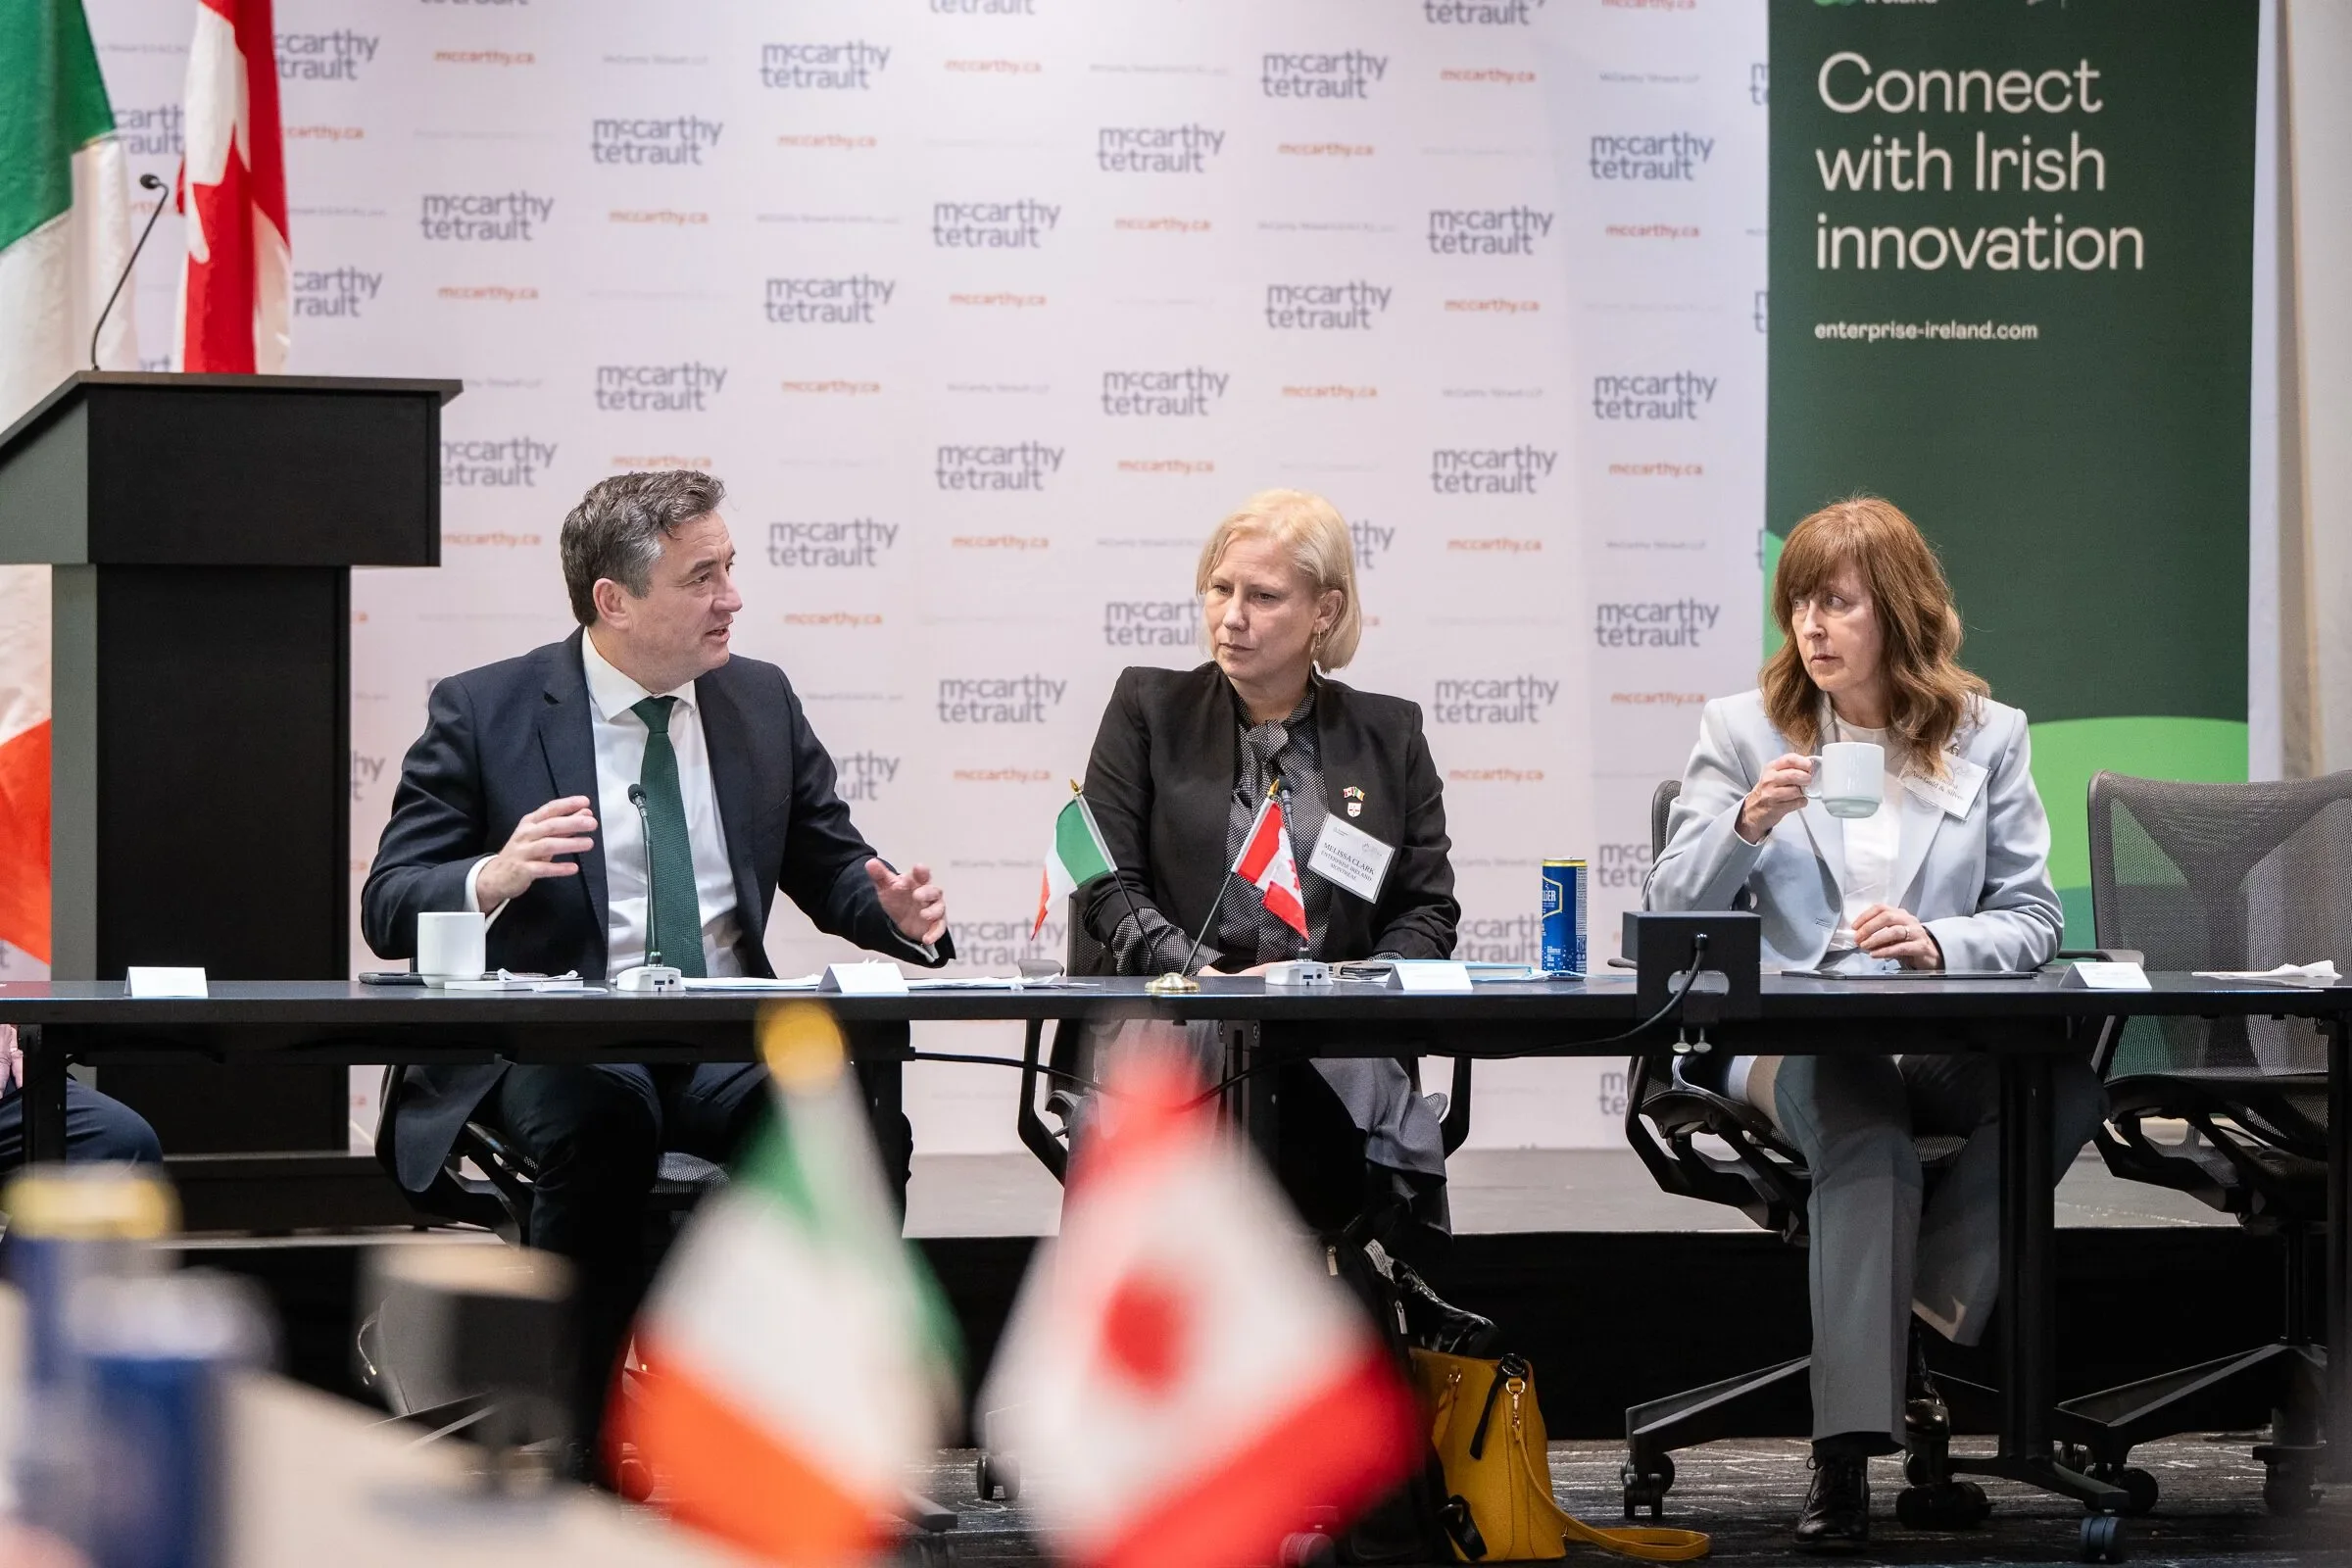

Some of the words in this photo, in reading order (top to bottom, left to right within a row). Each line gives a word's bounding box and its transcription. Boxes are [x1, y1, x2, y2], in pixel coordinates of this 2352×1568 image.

[1422, 0, 1531, 26] tetrault
[274, 28, 381, 63] ccarthy
[763, 39, 891, 73] mccarthy
[278, 54, 359, 80] trault
[760, 64, 869, 90] tetrault
[1264, 49, 1388, 81] mccarthy
[1260, 74, 1367, 99] tetrault
[1818, 52, 2103, 114] Connect
[595, 115, 723, 148] mccarthy
[1101, 123, 1225, 156] mccarthy
[591, 139, 702, 166] tetrault
[1097, 148, 1204, 173] tetrault
[1592, 131, 1715, 164] mccarthy
[1816, 131, 1952, 192] with
[1976, 131, 2105, 192] Irish
[1589, 156, 1694, 181] tetrault
[423, 190, 554, 223] mccarthy
[935, 198, 1060, 230] mccarthy
[419, 215, 532, 241] tetrault
[931, 222, 1040, 248] tetrault
[1431, 206, 1553, 237] mccarthy
[1427, 230, 1533, 255] tetrault
[1817, 214, 2144, 270] innovation
[767, 273, 896, 306] mccarthy
[1268, 280, 1392, 313] mccarthy
[294, 293, 361, 318] rault
[763, 298, 874, 323] tetrault
[1264, 305, 1371, 330] tetrault
[1814, 320, 2039, 343] enterprise-ireland.com
[598, 362, 727, 394] mccarthy
[1104, 367, 1230, 399] mccarthy
[1595, 370, 1718, 403] mccarthy
[594, 386, 706, 412] tetrault
[1101, 391, 1209, 416] tetrault
[1592, 395, 1697, 420] tetrault
[939, 440, 1065, 473] mccarthy
[1435, 444, 1557, 476] mccarthy
[440, 463, 536, 488] etrault
[935, 465, 1045, 491] tetrault
[1431, 468, 1537, 494] tetrault
[770, 517, 899, 550] mccarthy
[766, 542, 877, 567] tetrault
[1597, 598, 1720, 630] mccarthy
[1593, 622, 1699, 648] tetrault
[941, 673, 1067, 706] mccarthy
[1437, 675, 1559, 707] mccarthy
[937, 698, 1047, 723] tetrault
[1433, 700, 1539, 724] tetrault
[1324, 842, 1353, 862] MELISSA
[1352, 858, 1375, 875] CLARK
